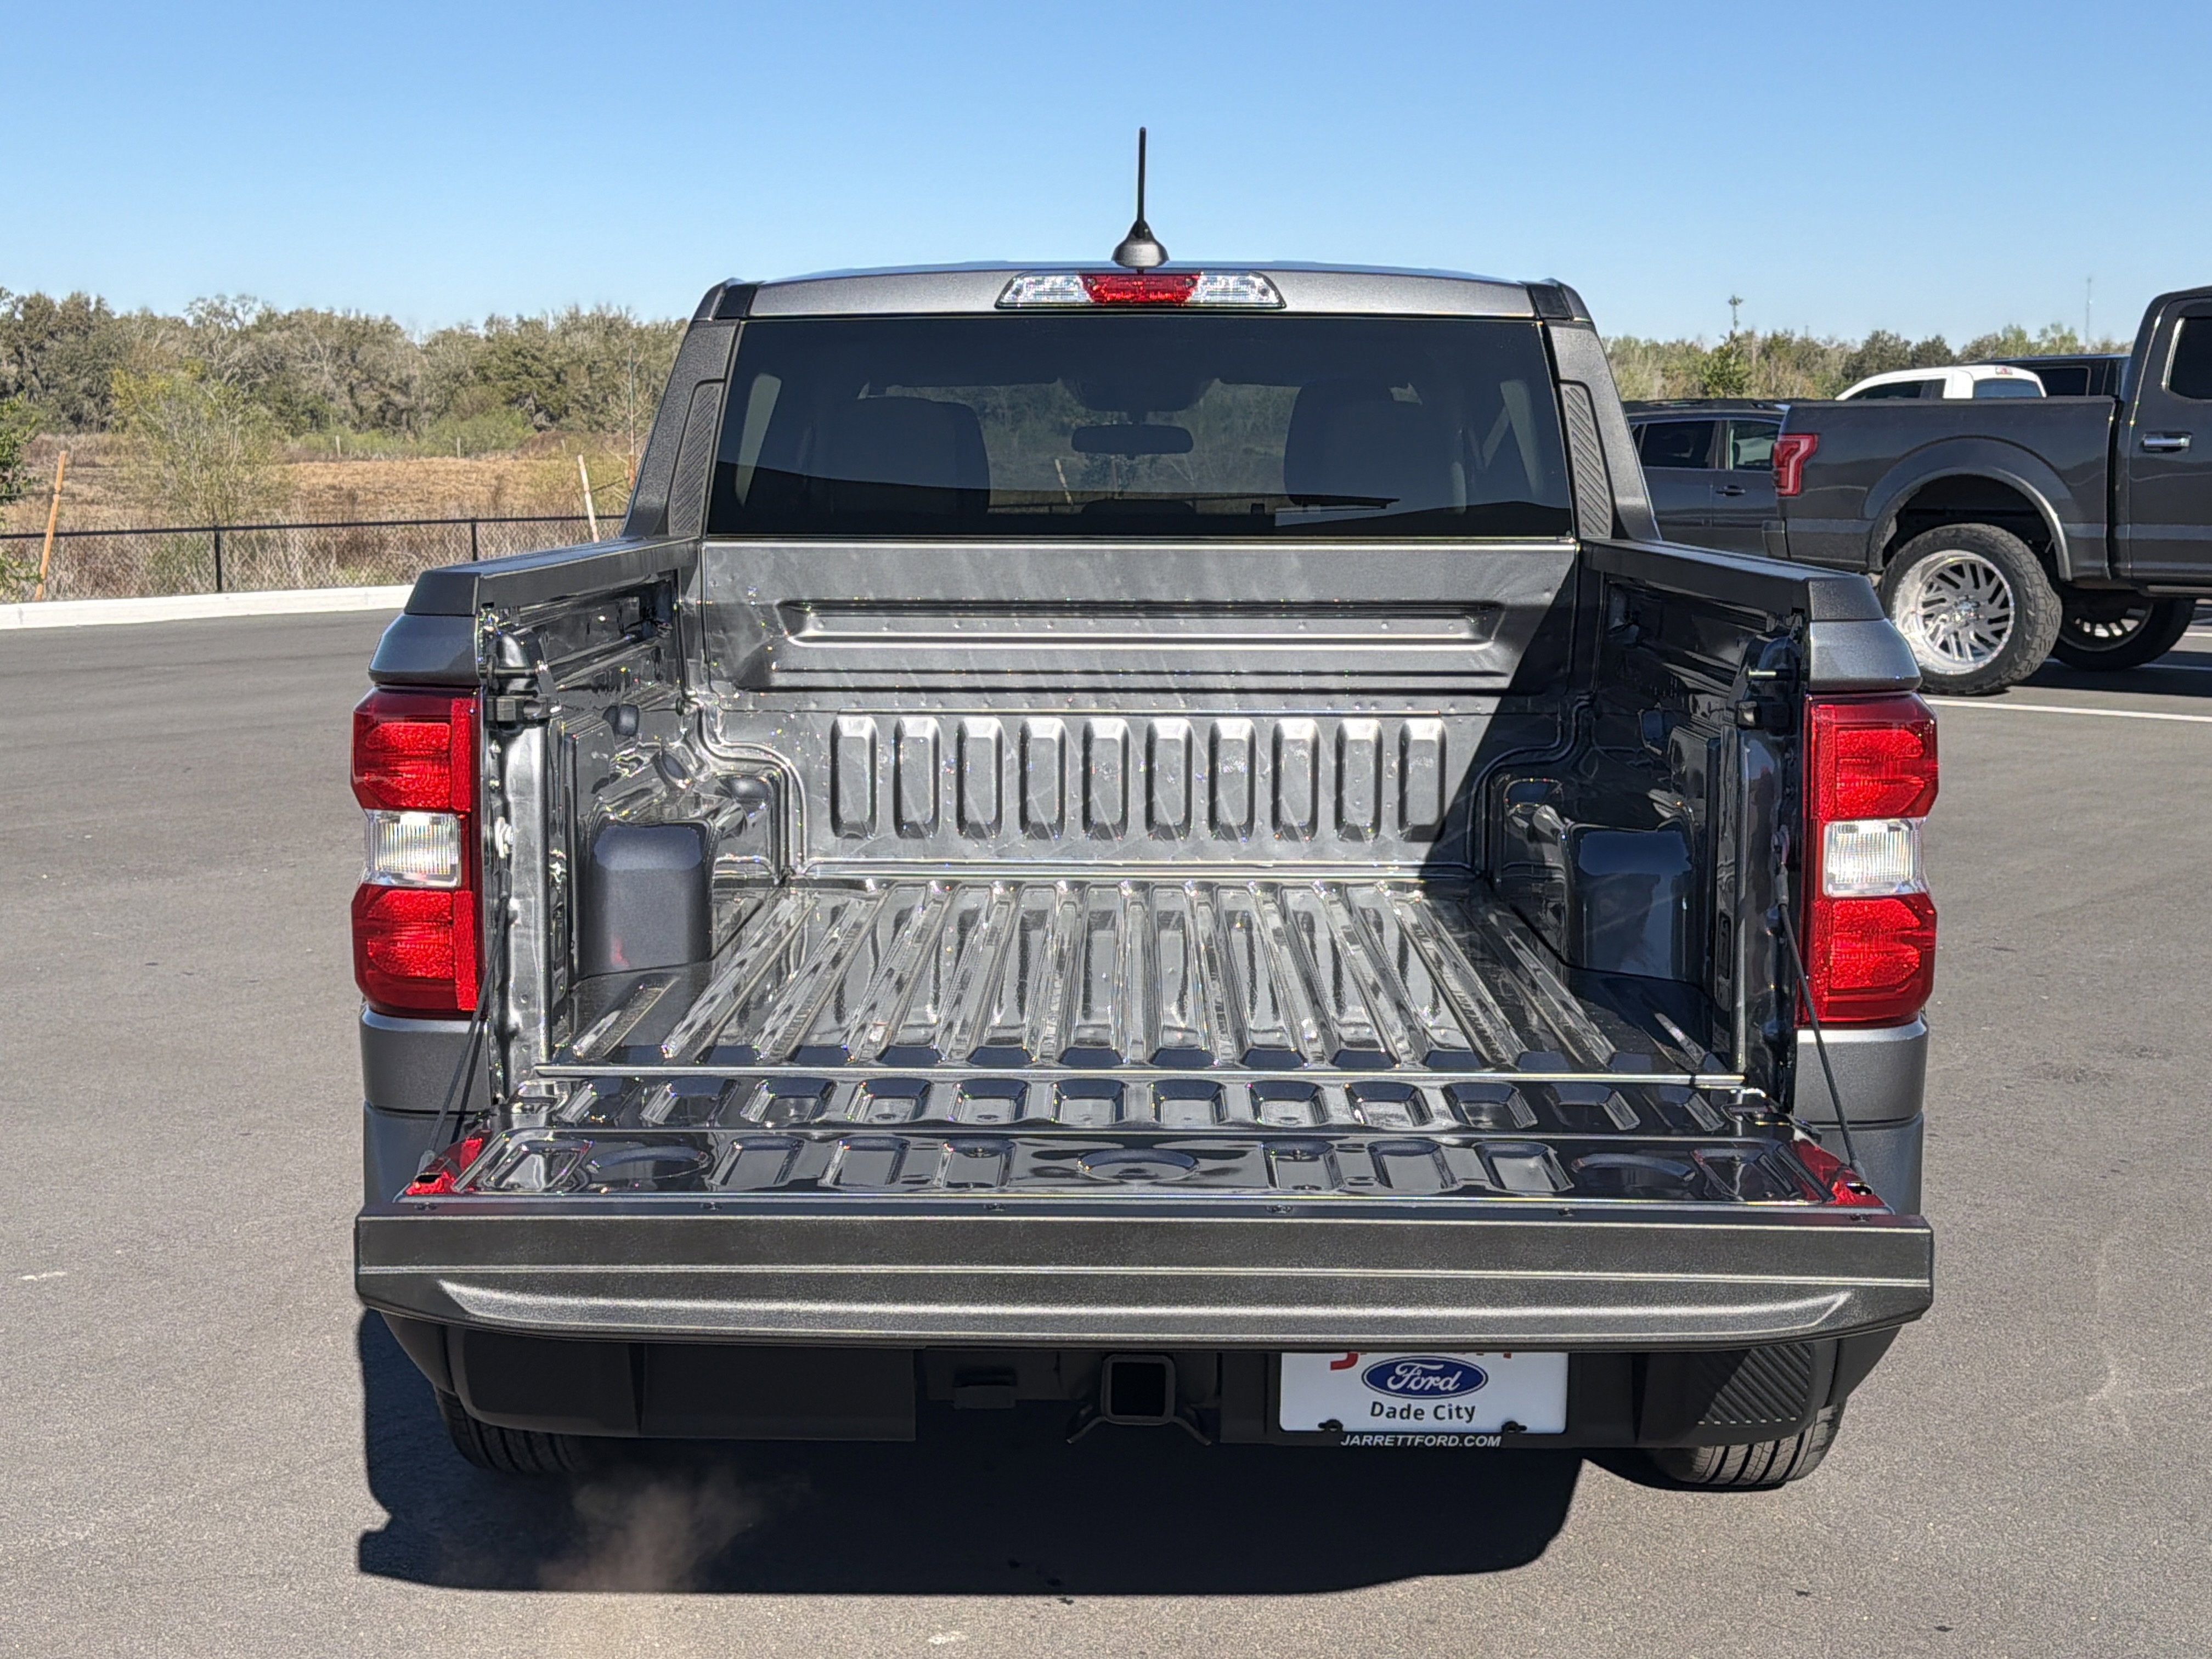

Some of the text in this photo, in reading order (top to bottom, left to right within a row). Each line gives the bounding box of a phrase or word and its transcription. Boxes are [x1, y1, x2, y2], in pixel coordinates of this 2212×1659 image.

[1387, 1363, 1462, 1391] Ford
[1370, 1401, 1476, 1423] Dade City
[1341, 1435, 1502, 1447] JARRETTFORD.COM
